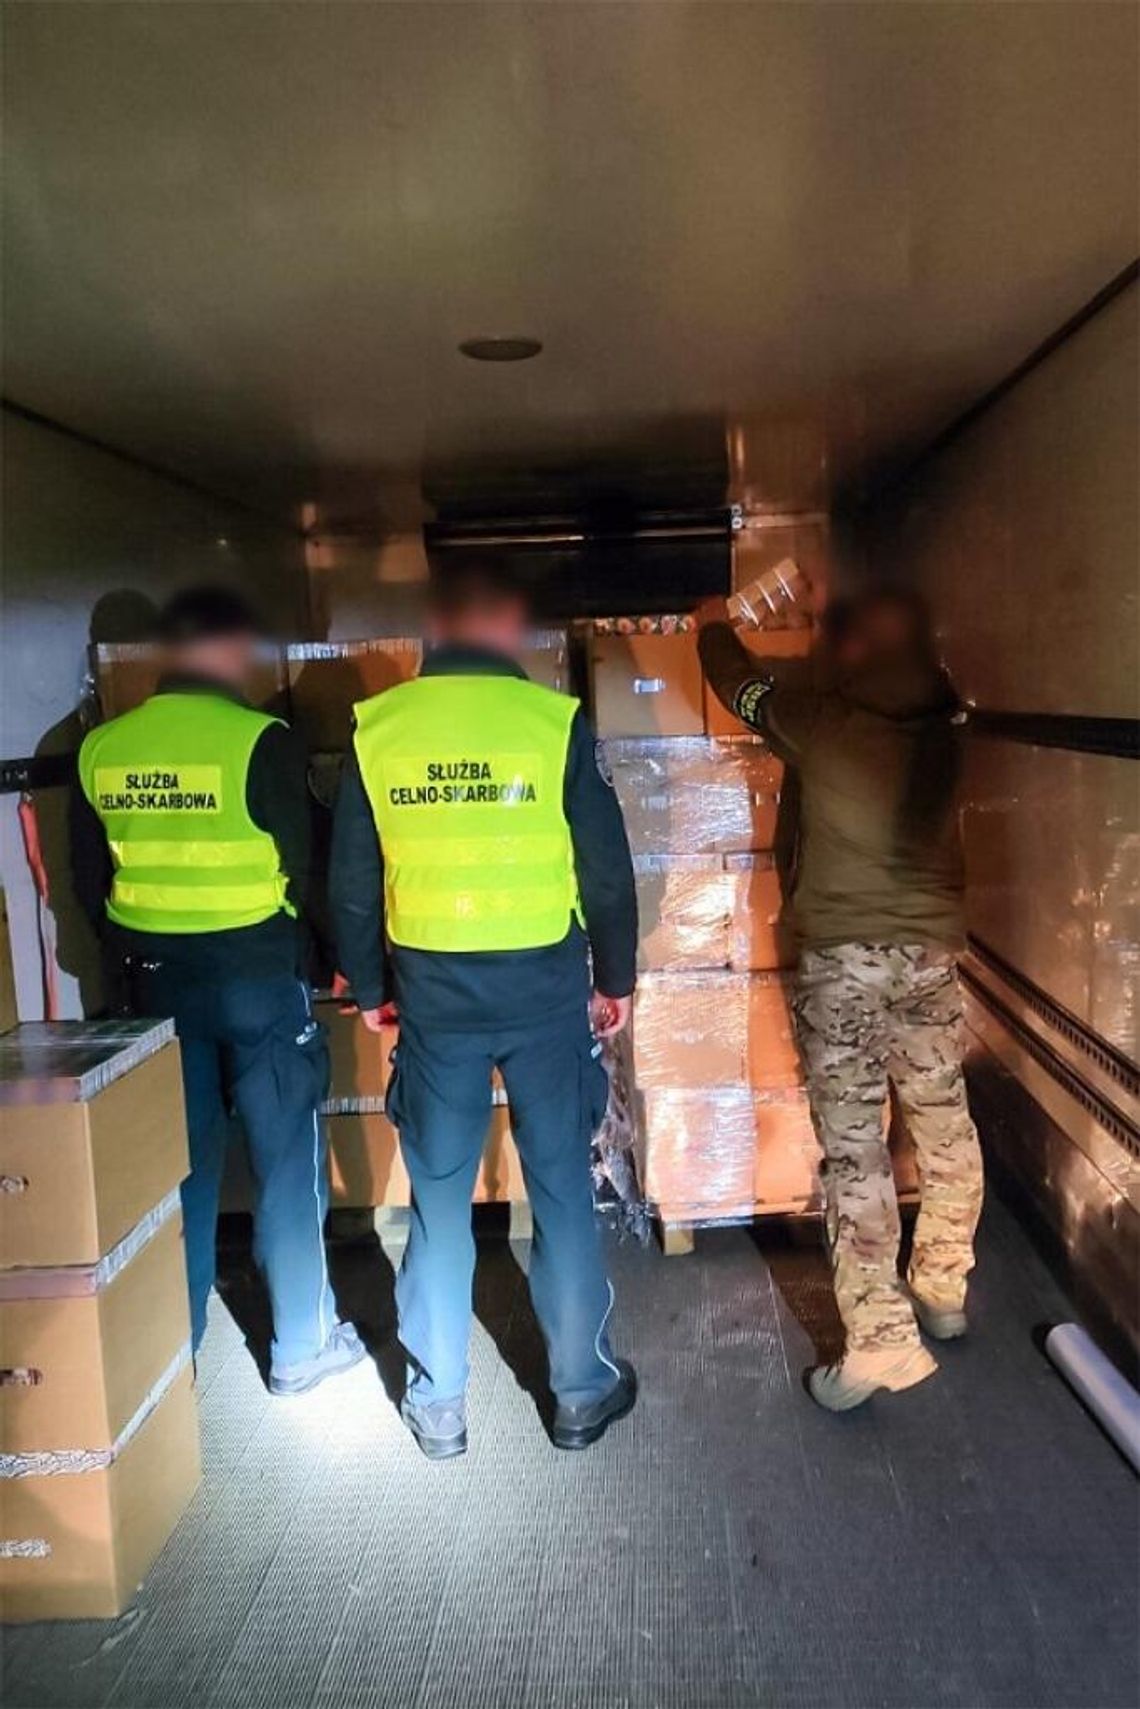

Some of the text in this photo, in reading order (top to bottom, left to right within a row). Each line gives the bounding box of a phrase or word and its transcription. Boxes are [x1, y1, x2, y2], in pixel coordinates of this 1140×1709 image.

[126, 769, 179, 789] SŁUŻBA
[427, 758, 491, 781] SŁUŻBA
[390, 783, 536, 805] CELNO-SKARBOWA
